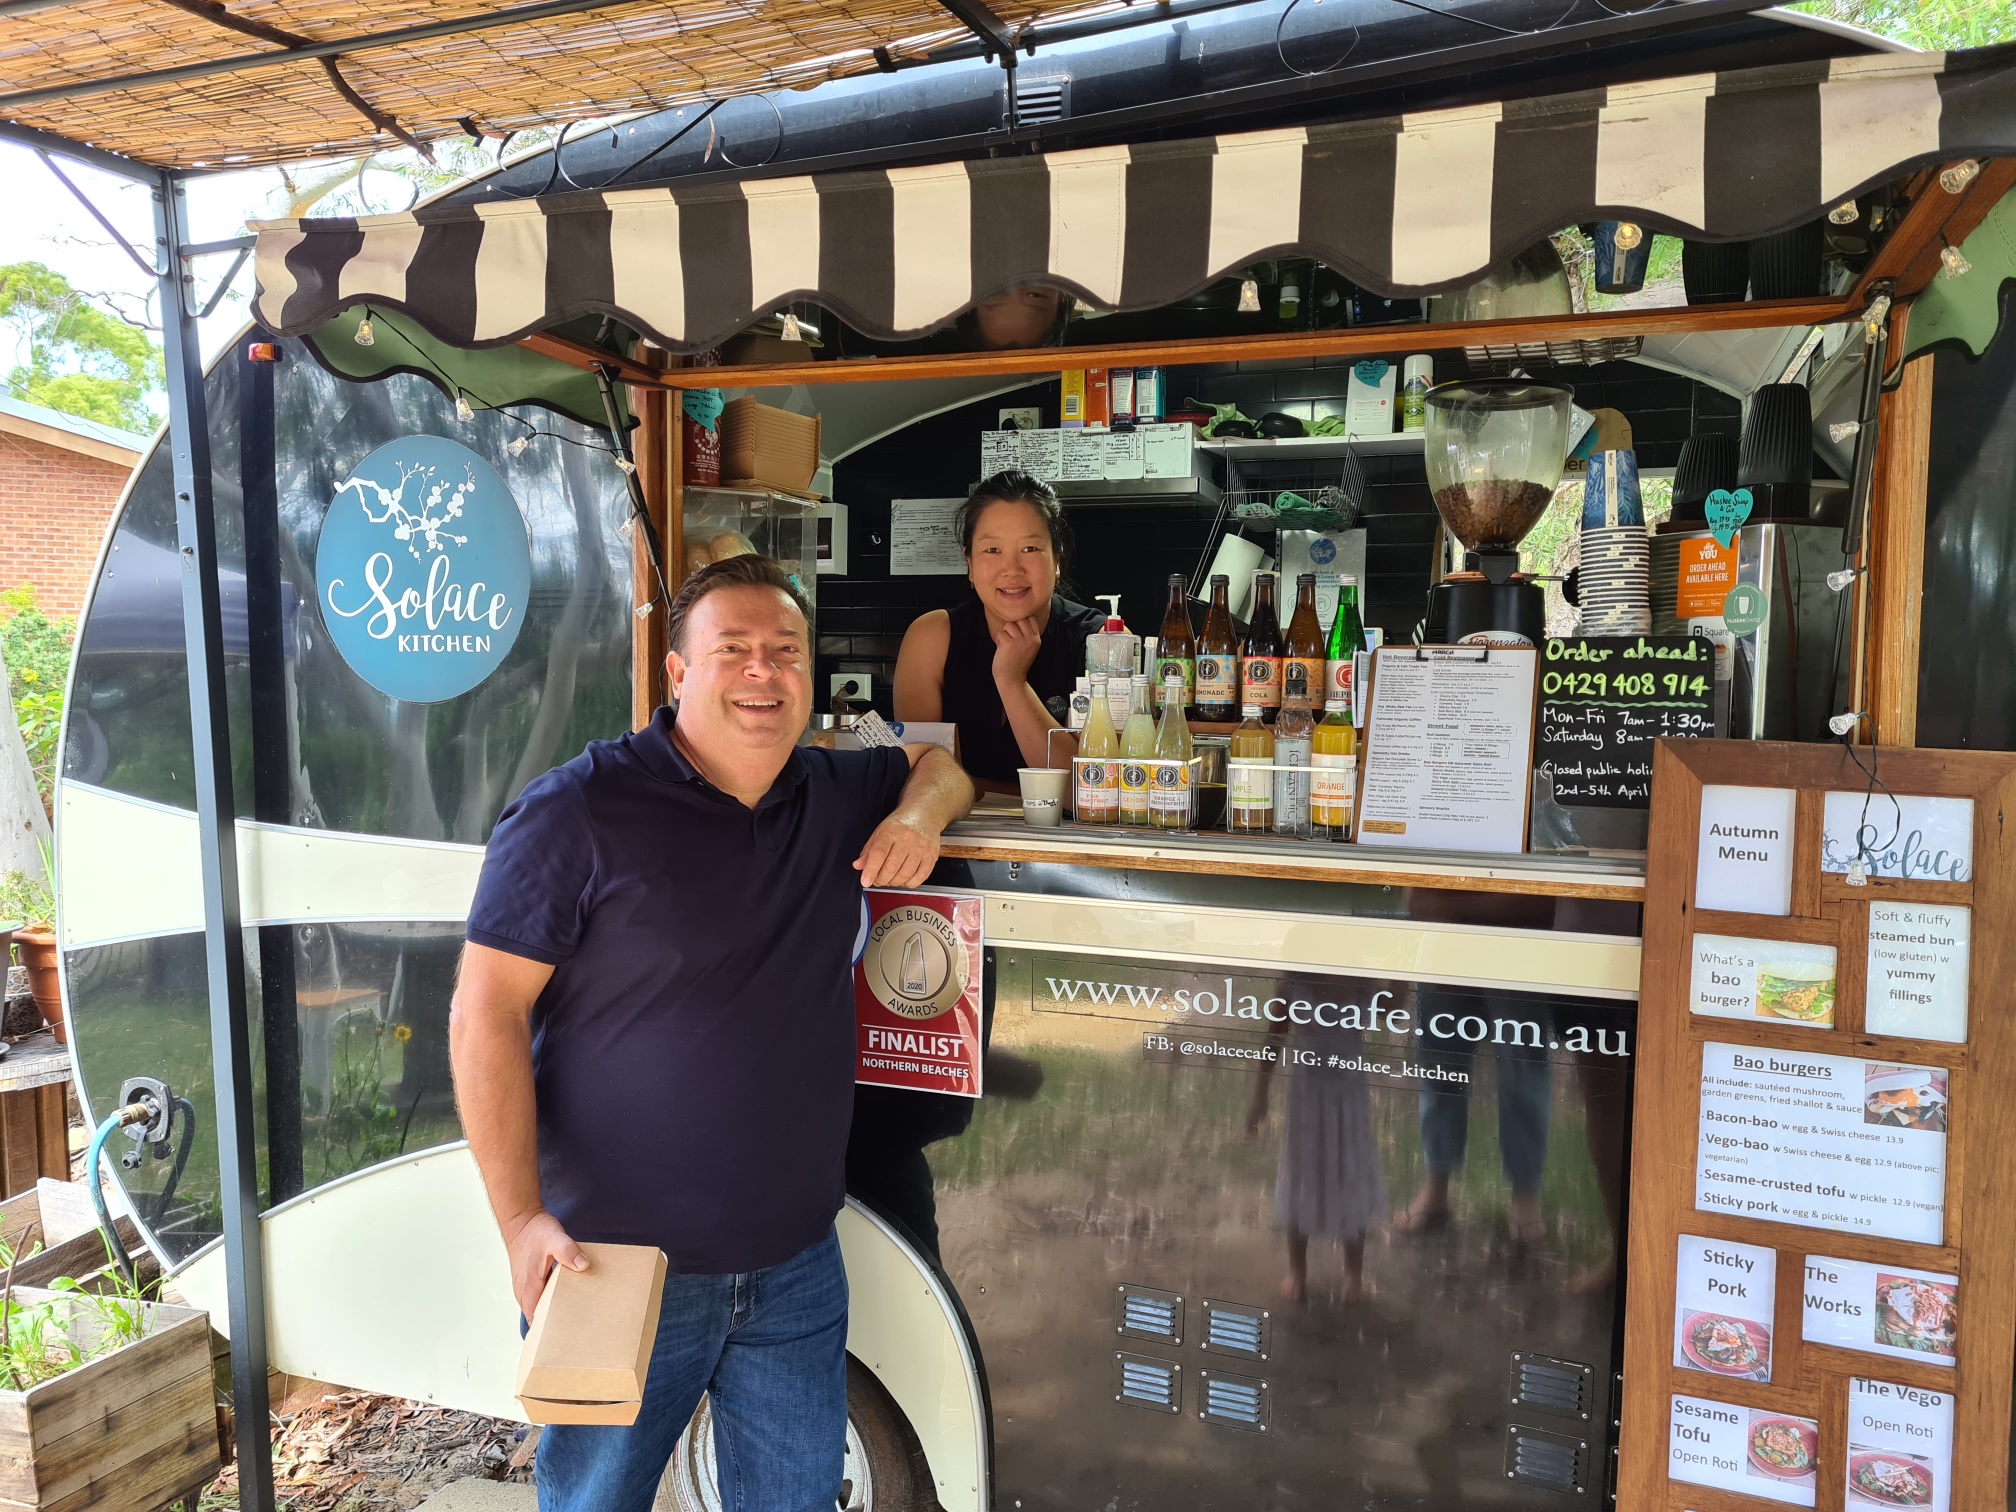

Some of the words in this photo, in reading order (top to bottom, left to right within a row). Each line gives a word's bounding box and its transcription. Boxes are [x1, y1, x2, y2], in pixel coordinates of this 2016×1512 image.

[1709, 494, 1731, 506] Huskee
[1733, 494, 1748, 507] Swap
[1700, 550, 1718, 560] YOU
[1690, 564, 1707, 572] ORDER
[1708, 562, 1726, 571] AHEAD
[1686, 574, 1713, 583] AVAILABLE
[1715, 573, 1728, 582] HERE
[328, 552, 512, 639] Solace
[398, 634, 490, 652] KITCHEN
[1705, 628, 1729, 637] Square
[1546, 638, 1613, 662] Order
[1623, 637, 1708, 661] ahead:
[1543, 672, 1607, 696] 0429
[1612, 673, 1656, 696] 408
[1663, 673, 1712, 697] 914
[1543, 707, 1605, 724] Mon-Fri
[1661, 711, 1715, 732] 1:30pm
[1543, 726, 1604, 750] Saturday
[1586, 761, 1621, 779] public
[1627, 762, 1653, 776] holi
[1317, 782, 1345, 790] ORANGE
[1555, 784, 1611, 796] 2nd-5th
[1618, 783, 1648, 800] April
[1709, 822, 1779, 841] Autumn
[1718, 845, 1768, 862] Menu
[1855, 824, 1969, 882] Solace
[871, 910, 903, 943] LOCAL
[906, 909, 958, 947] BUSINESS
[1874, 910, 1899, 923] Soft
[1903, 912, 1913, 923] &
[1918, 913, 1951, 928] fluffy
[1869, 930, 1925, 945] steamed
[1929, 933, 1955, 946] bun
[1700, 952, 1744, 967] What’s
[1747, 959, 1754, 967] a
[1874, 948, 1895, 960] (low
[1899, 952, 1937, 966] gluten)
[1711, 971, 1741, 987] bao
[1886, 968, 1935, 983] yummy
[907, 982, 923, 991] 2020
[1889, 988, 1932, 1004] fillings
[887, 998, 939, 1016] AWARDS
[1700, 992, 1750, 1008] burger?
[1045, 977, 1631, 1057] www.solacecafe.com.au
[868, 1030, 964, 1058] FINALIST
[862, 1057, 919, 1073] NORTHERN
[922, 1064, 969, 1079] BEACHES
[1145, 1035, 1174, 1052] FB:
[1180, 1040, 1277, 1062] @solacecafe
[1292, 1050, 1322, 1067] IG:
[1327, 1053, 1470, 1084] #solace_kitchen
[1733, 1054, 1764, 1070] Bao
[1769, 1058, 1832, 1077] burgers
[1702, 1076, 1714, 1084] All
[1716, 1077, 1752, 1089] include:
[1755, 1081, 1790, 1093] sautéed
[1793, 1086, 1845, 1100] mushroom,
[1701, 1088, 1732, 1099] garden
[1734, 1092, 1767, 1103] greens,
[1769, 1095, 1790, 1105] fried
[1793, 1098, 1823, 1109] shallot
[1826, 1101, 1833, 1109] &
[1836, 1105, 1862, 1114] sauce
[1706, 1109, 1778, 1129] Bacon-bao
[1792, 1124, 1808, 1134] egg
[1811, 1125, 1818, 1133] &
[1821, 1126, 1846, 1137] Swiss
[1848, 1130, 1880, 1141] cheese
[1886, 1136, 1903, 1145] 13.9
[1704, 1153, 1748, 1165] vegetarian)
[1705, 1133, 1769, 1151] Vego-bao
[1783, 1146, 1807, 1157] Swiss
[1810, 1149, 1842, 1161] cheese
[1845, 1153, 1852, 1162] &
[1855, 1156, 1871, 1166] egg
[1874, 1158, 1892, 1167] 12.9
[1894, 1160, 1922, 1172] (above
[1704, 1169, 1812, 1194] Sesame-crusted
[1817, 1184, 1845, 1198] tofu
[1860, 1193, 1887, 1205] pickle
[1893, 1198, 1911, 1207] 12.9
[1913, 1200, 1943, 1212] (vegan)
[1703, 1192, 1743, 1210] Sticky
[1747, 1200, 1778, 1214] pork
[1792, 1209, 1809, 1219] egg
[1811, 1211, 1819, 1219] &
[1822, 1211, 1849, 1223] pickle
[1854, 1217, 1871, 1226] 14.9
[1703, 1249, 1754, 1273] Sticky
[1805, 1266, 1838, 1283] The
[1708, 1278, 1747, 1298] Pork
[1805, 1293, 1862, 1317] Works
[1855, 1378, 1890, 1397] The
[1896, 1384, 1942, 1408] Vego
[1674, 1399, 1739, 1425] Sesame
[1674, 1423, 1710, 1444] Tofu
[1862, 1415, 1900, 1433] Open
[1905, 1424, 1933, 1439] Roti
[1672, 1448, 1708, 1466] Open
[1713, 1456, 1738, 1472] Roti
